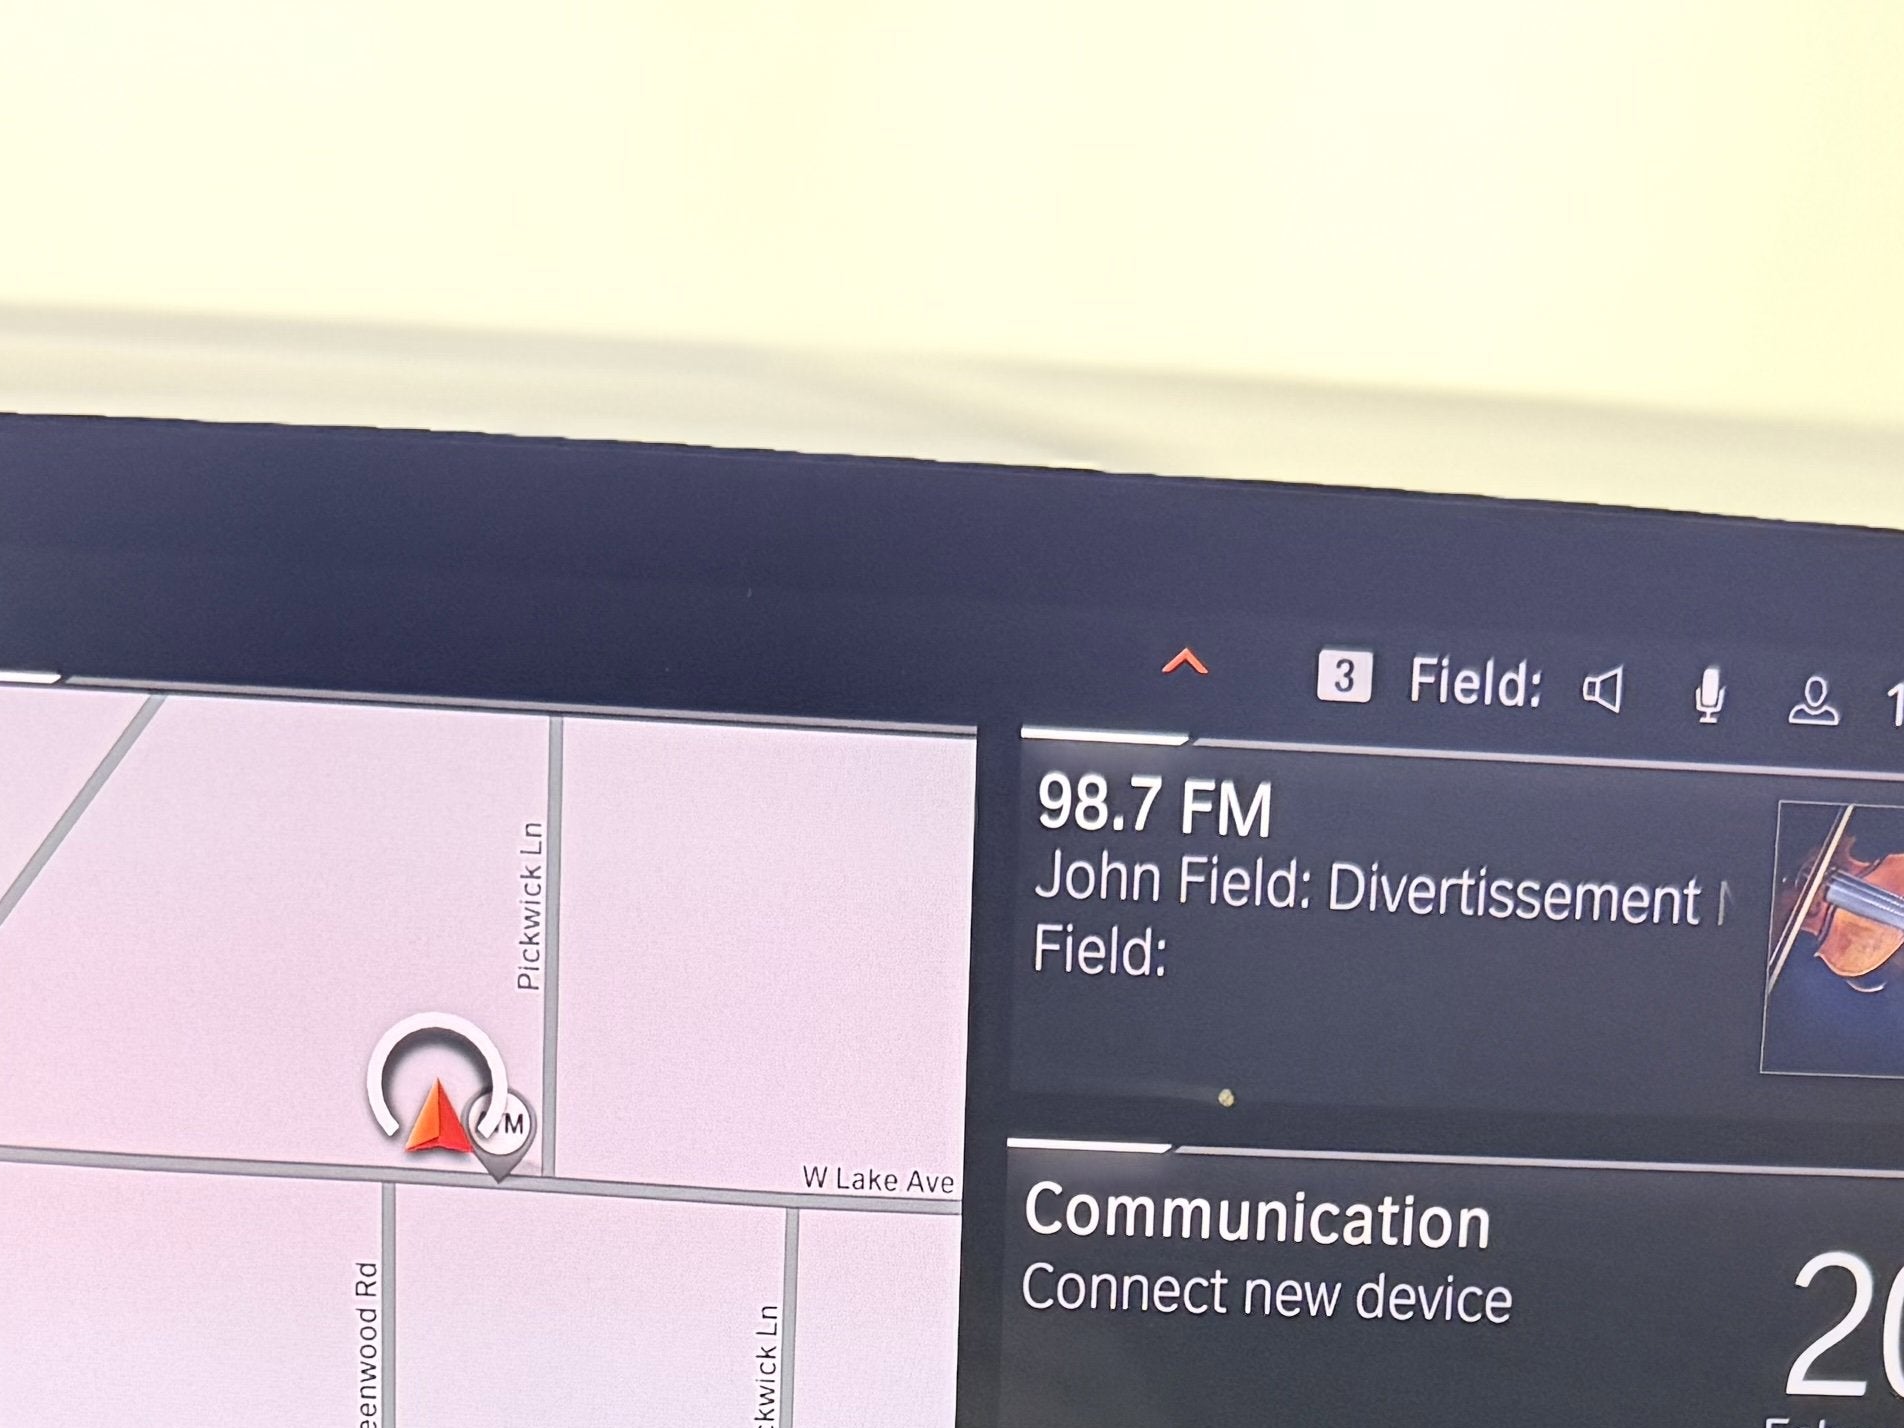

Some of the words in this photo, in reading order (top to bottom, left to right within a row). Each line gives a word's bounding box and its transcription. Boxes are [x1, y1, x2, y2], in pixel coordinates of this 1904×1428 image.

[1334, 659, 1355, 693] 3
[1411, 654, 1542, 708] Field:
[1038, 770, 1163, 832] 98.7
[1182, 779, 1272, 839] FM
[522, 821, 543, 857] Ln
[1034, 849, 1161, 902] John
[1179, 855, 1311, 910] Field:
[1329, 861, 1702, 926] Divertissement
[517, 863, 542, 991] Pickwick
[1034, 923, 1166, 977] Field:
[802, 1165, 832, 1191] W
[836, 1167, 899, 1192] Lake
[905, 1169, 955, 1195] Ave
[1024, 1180, 1491, 1250] Communication
[354, 1262, 378, 1297] Rd
[1021, 1261, 1228, 1316] Connect
[1243, 1276, 1342, 1319] new
[1354, 1272, 1514, 1325] device
[756, 1303, 779, 1339] Ln
